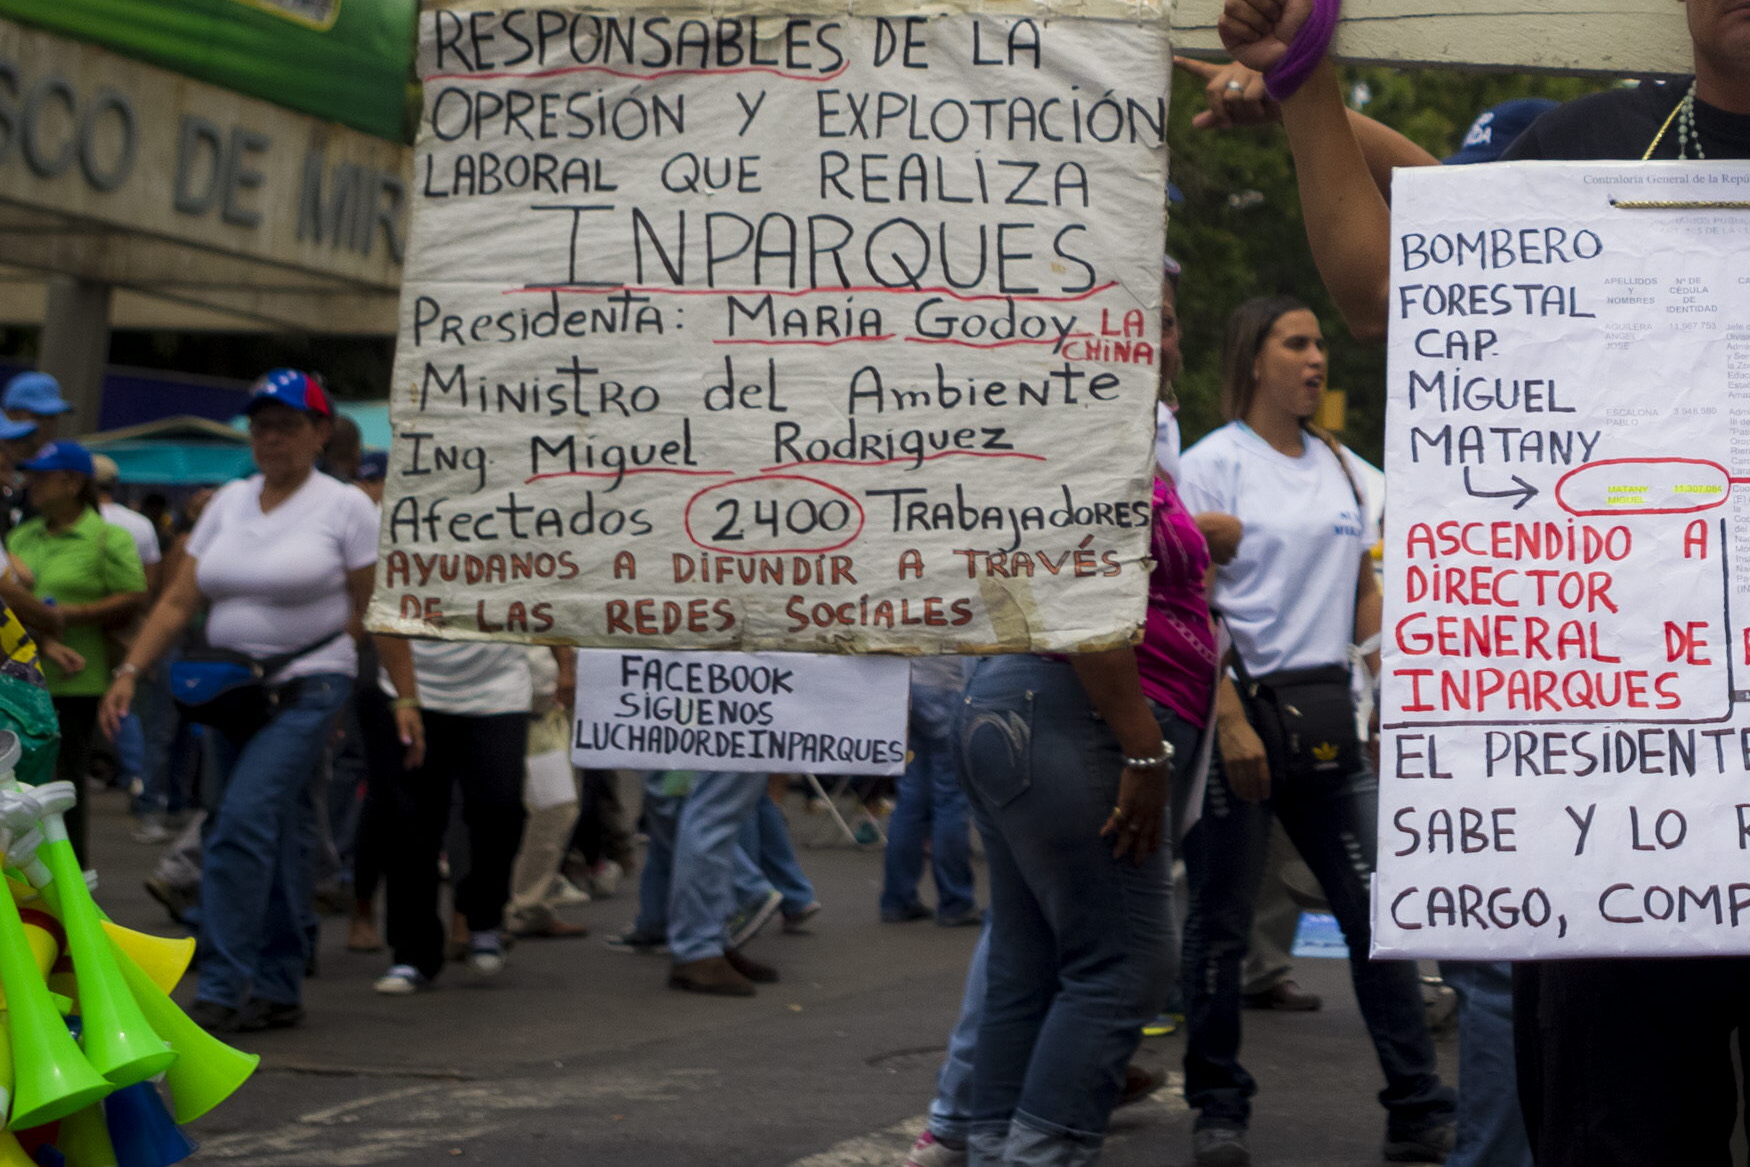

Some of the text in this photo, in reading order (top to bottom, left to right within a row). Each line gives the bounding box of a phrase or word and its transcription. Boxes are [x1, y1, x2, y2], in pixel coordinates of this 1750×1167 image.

[437, 11, 1041, 74] RESPONSABLES DE LA
[431, 88, 1166, 143] OPRESIÓN Y EXPLOTACIÓN
[174, 112, 270, 230] DE
[423, 150, 1088, 207] LABORAL QUE REALIZA
[1646, 174, 1690, 184] General
[1692, 174, 1706, 184] de
[1708, 174, 1719, 184] la
[523, 205, 1096, 292] INPARQUES
[1401, 227, 1603, 271] BOMBERO
[1399, 283, 1596, 319] FORESTAL
[1604, 277, 1658, 285] APELLIDOS
[1607, 296, 1655, 304] NOMBRES
[1670, 285, 1709, 294] CÉDULA
[1683, 296, 1696, 304] DE
[915, 295, 1077, 354] Godoy
[1101, 309, 1144, 338] LA
[1666, 304, 1718, 314] IDENTIDAD
[1062, 341, 1153, 365] CHINA
[1415, 329, 1498, 361] CAP.
[703, 355, 788, 412] del
[1409, 367, 1576, 413] MIGUEL
[532, 417, 697, 493] Miguel
[775, 417, 1014, 471] Rodriguez
[1411, 424, 1601, 466] MATANY
[389, 536, 1121, 586] AYUDANOS A DIFUNDIR A TRAVÉS
[1407, 518, 1631, 562] ASCENDIDO
[1684, 519, 1707, 559] A
[1407, 563, 1618, 614] DIRECTOR
[401, 594, 970, 633] DE LAS REDES SOCIALES
[1395, 612, 1712, 665] GENERAL DE
[621, 655, 793, 695] FACEBOOK
[1401, 668, 1681, 712] INPARQUES
[620, 693, 773, 726] SIGUENOS
[575, 723, 904, 764] LUCHADORDEINPARQUES
[1396, 734, 1453, 779] EL
[1394, 807, 1517, 856] SABE
[1565, 804, 1596, 856] Y
[1629, 806, 1687, 851] LO
[1391, 884, 1567, 938] CARGO,
